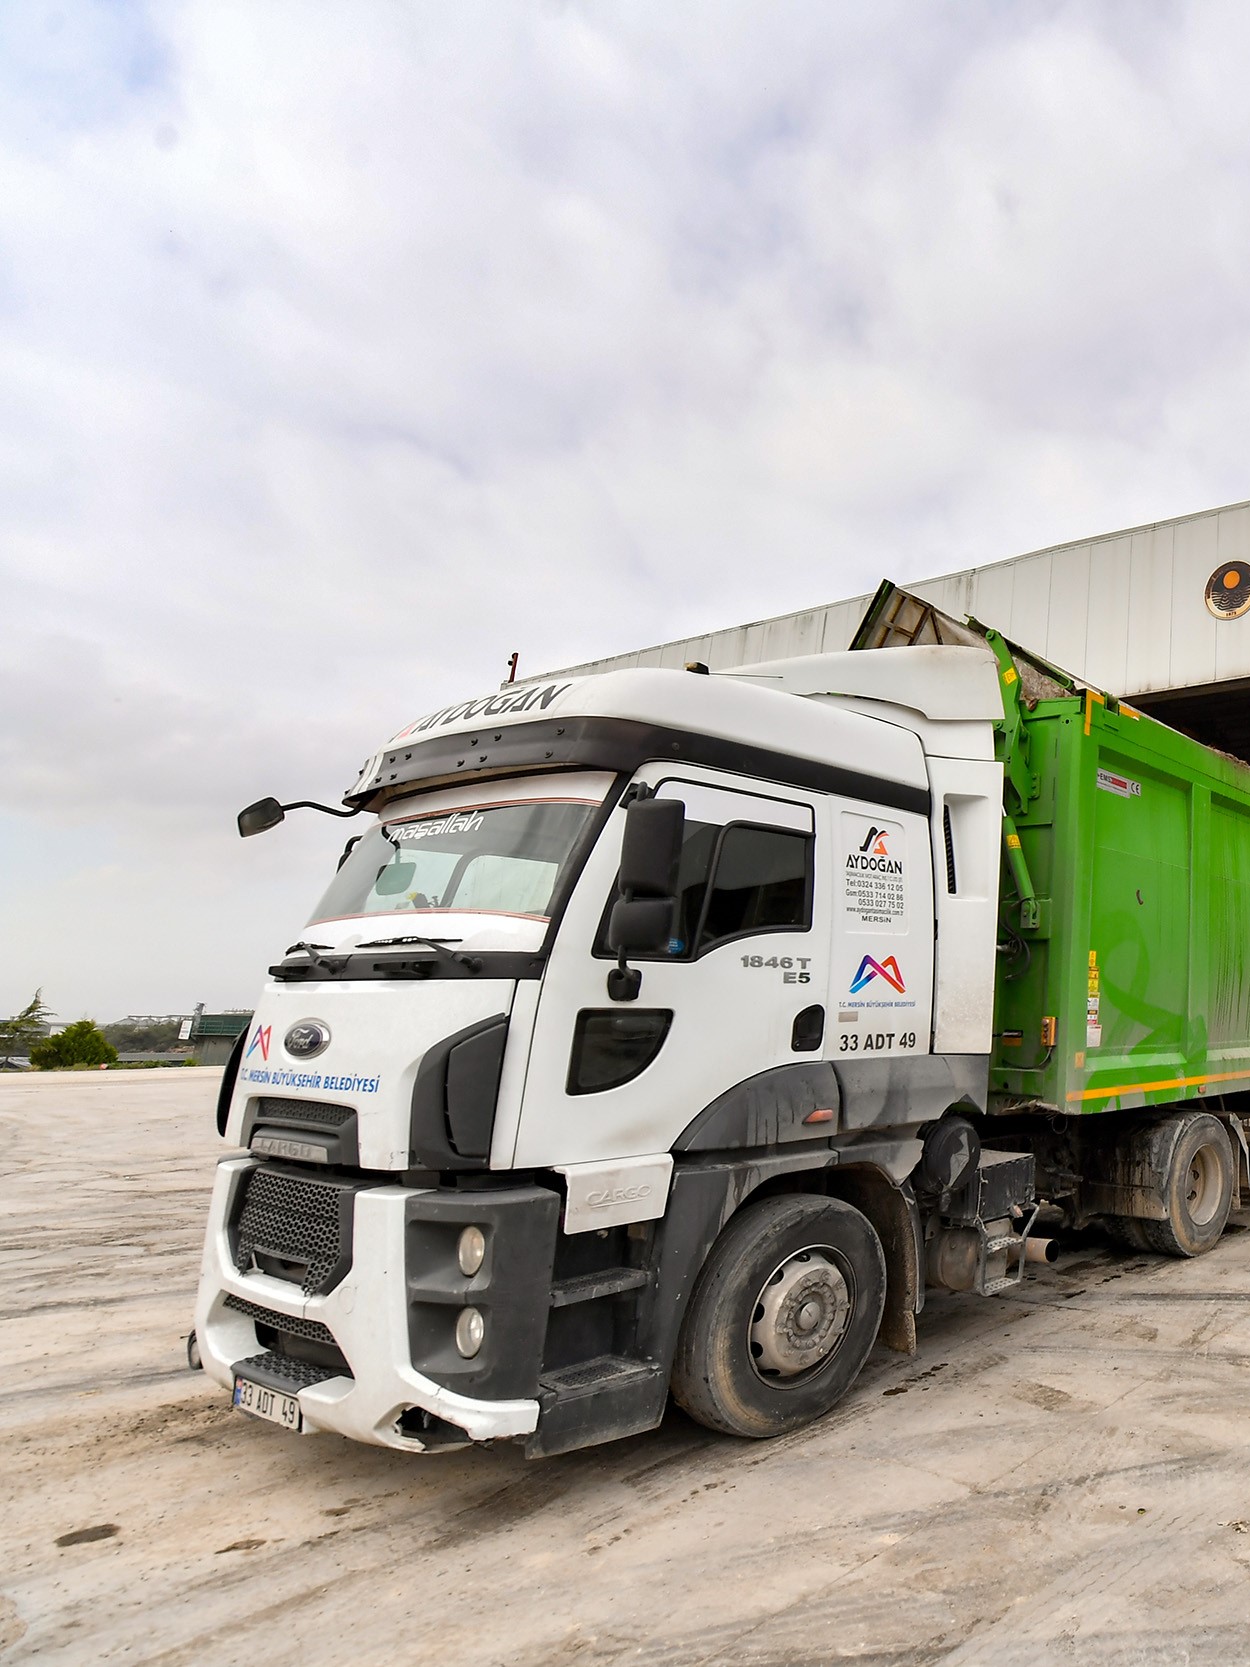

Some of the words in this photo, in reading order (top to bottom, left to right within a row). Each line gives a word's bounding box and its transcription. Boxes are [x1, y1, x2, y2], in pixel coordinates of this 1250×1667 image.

[846, 854, 903, 874] AYDOĞAN
[875, 891, 887, 899] 714
[887, 892, 895, 901] 02
[887, 883, 895, 892] 12
[895, 884, 904, 892] 05
[858, 898, 874, 907] 0533
[741, 955, 792, 969] 1846
[796, 958, 811, 969] T
[783, 972, 811, 984] E5
[287, 1030, 314, 1049] Ford
[839, 1034, 858, 1051] 33
[863, 1033, 895, 1050] ADT
[899, 1032, 916, 1048] 49
[249, 1067, 270, 1083] MERSİN
[271, 1068, 321, 1091] BÜYÜKŞEHİR
[323, 1073, 381, 1093] BELEDİYESİ
[586, 1184, 652, 1207] CARGO
[241, 1382, 253, 1406] 33
[256, 1389, 275, 1416] ADT
[282, 1398, 296, 1424] 49
